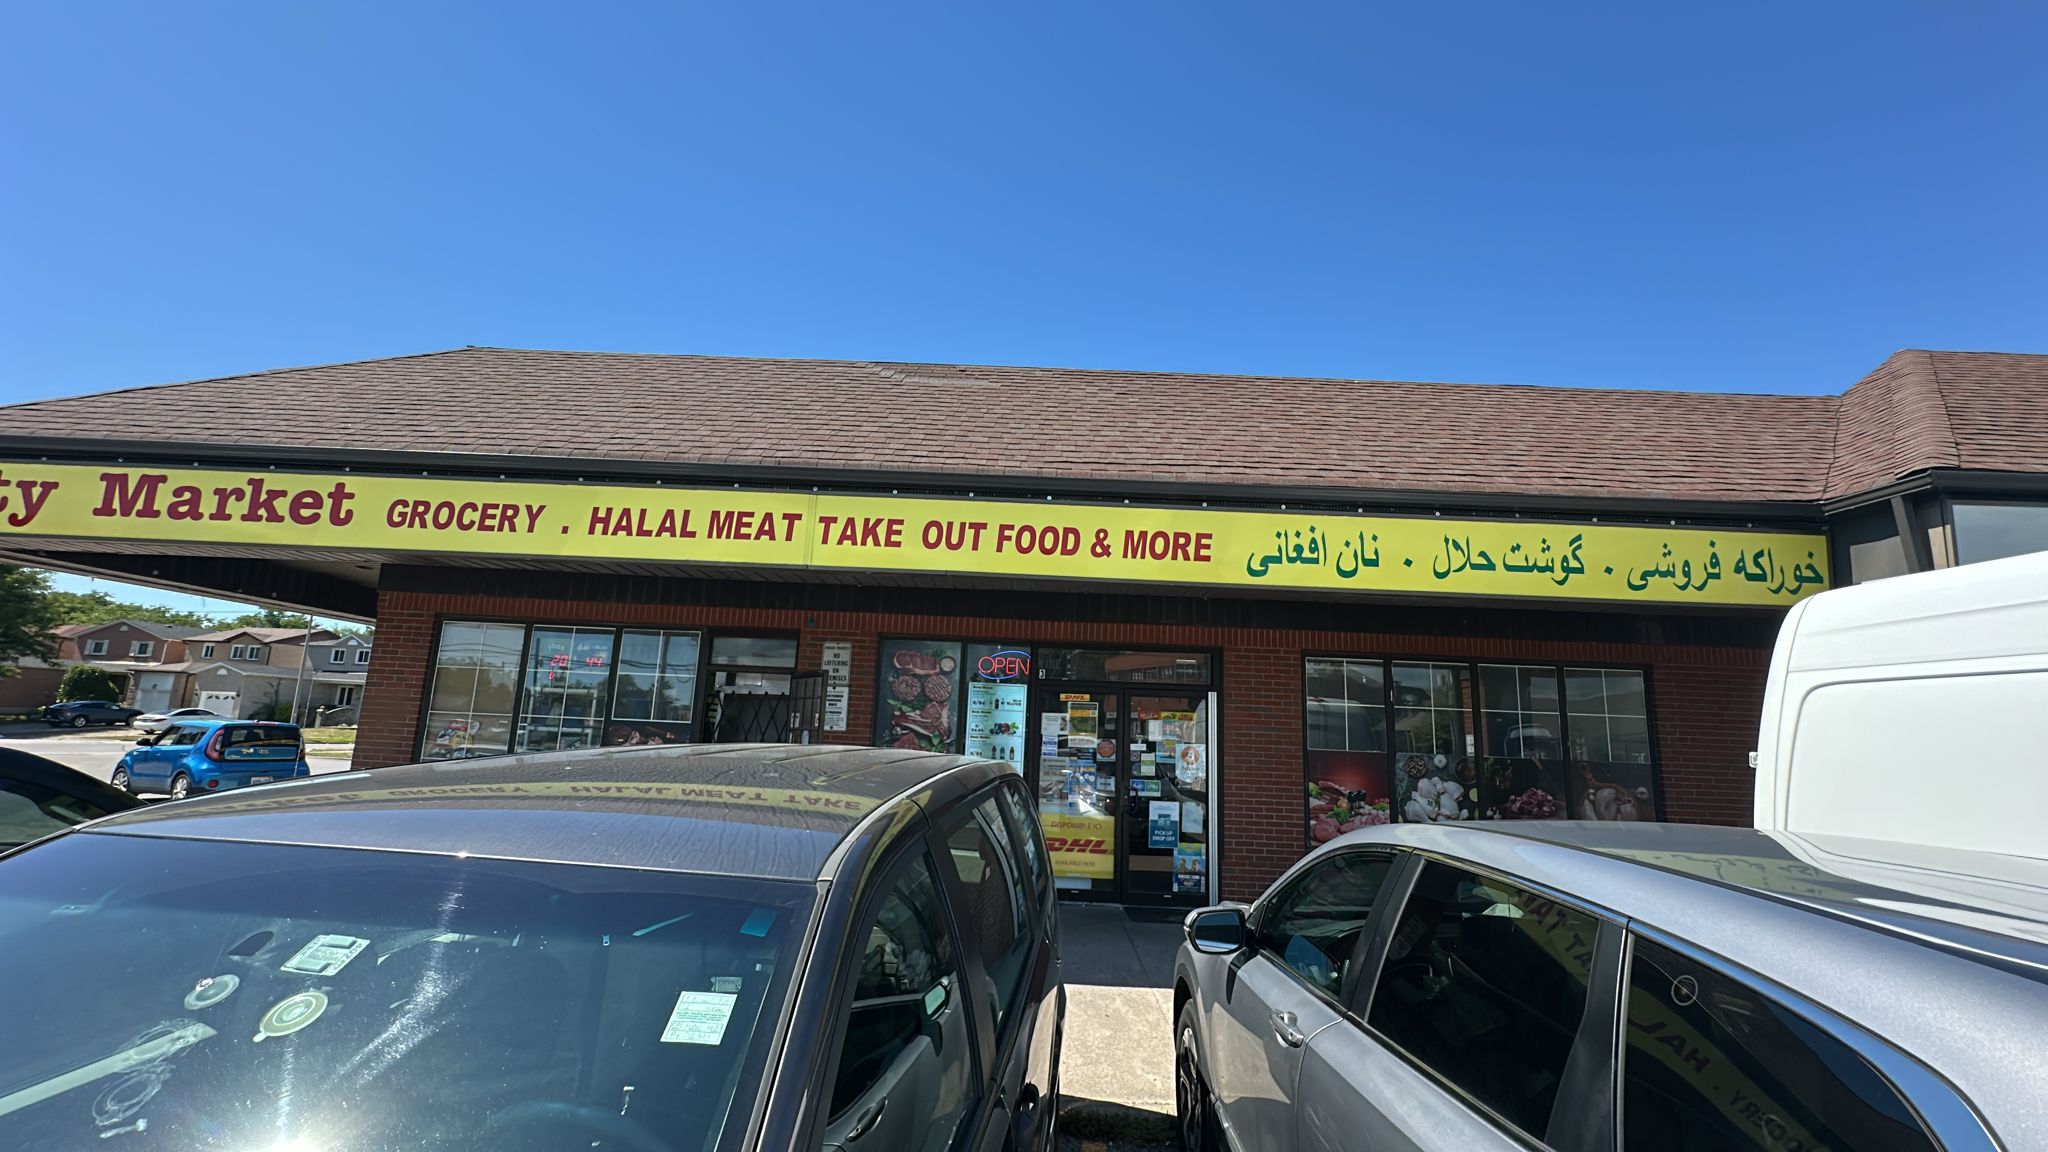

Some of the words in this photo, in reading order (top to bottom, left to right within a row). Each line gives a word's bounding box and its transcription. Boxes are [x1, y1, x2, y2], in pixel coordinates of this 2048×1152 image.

[93, 473, 354, 526] Market
[387, 499, 544, 533] GROCERY
[588, 507, 697, 539] HALAL
[708, 510, 802, 541] MEAT
[820, 515, 905, 548] TAKE
[922, 520, 988, 552] OUT
[996, 523, 1081, 556] FOOD
[1090, 528, 1111, 558] &
[1123, 529, 1213, 562] MORE
[1335, 530, 1380, 579] نان
[1432, 534, 1498, 580] حلال
[1502, 533, 1585, 585] گوشت
[978, 656, 1030, 675] OPEN
[1046, 837, 1109, 854] DHL
